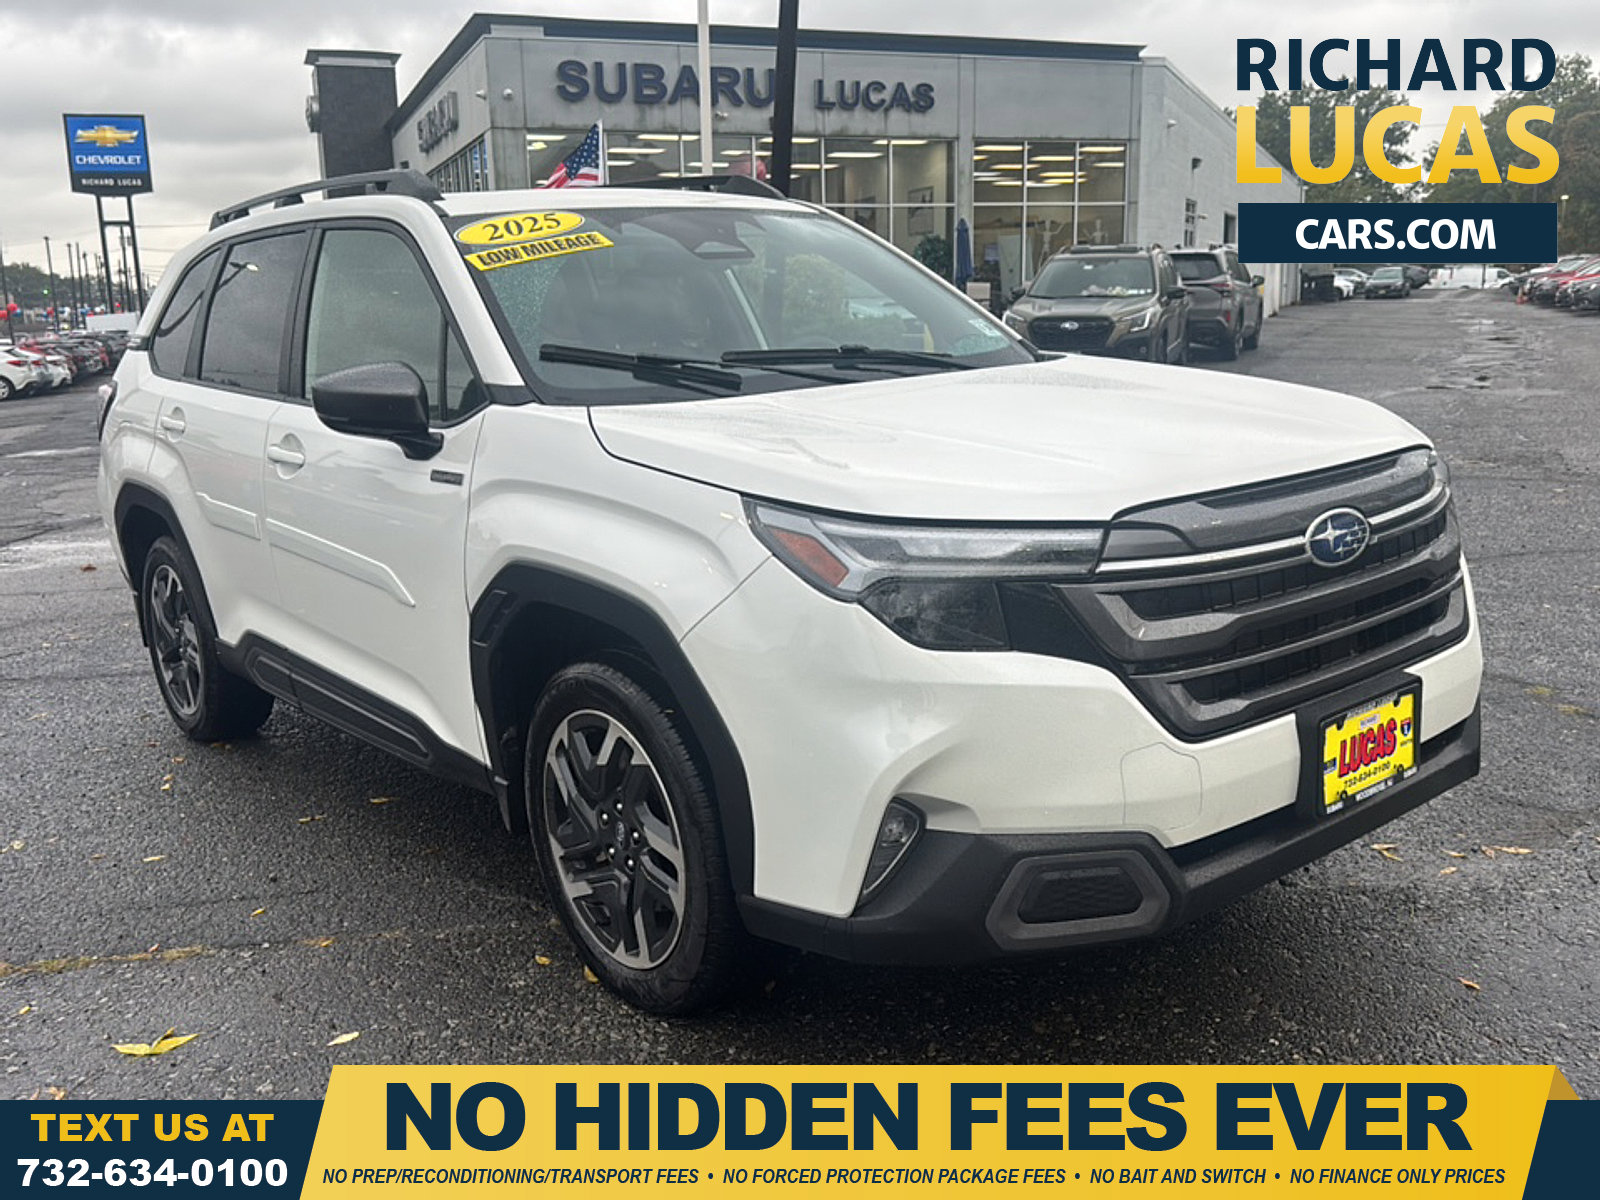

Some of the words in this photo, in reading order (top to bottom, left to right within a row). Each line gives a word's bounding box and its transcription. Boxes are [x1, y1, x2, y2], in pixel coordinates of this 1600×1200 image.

[556, 60, 775, 108] SUBARU
[814, 79, 935, 113] LUCAS
[75, 154, 142, 165] CHEVROLET
[81, 178, 115, 187] RICHARD
[117, 178, 142, 187] LUCAS
[482, 213, 561, 241] 2025
[477, 247, 522, 266] LOW
[520, 234, 600, 257] MILEAGE
[1338, 718, 1397, 778] LUCAS
